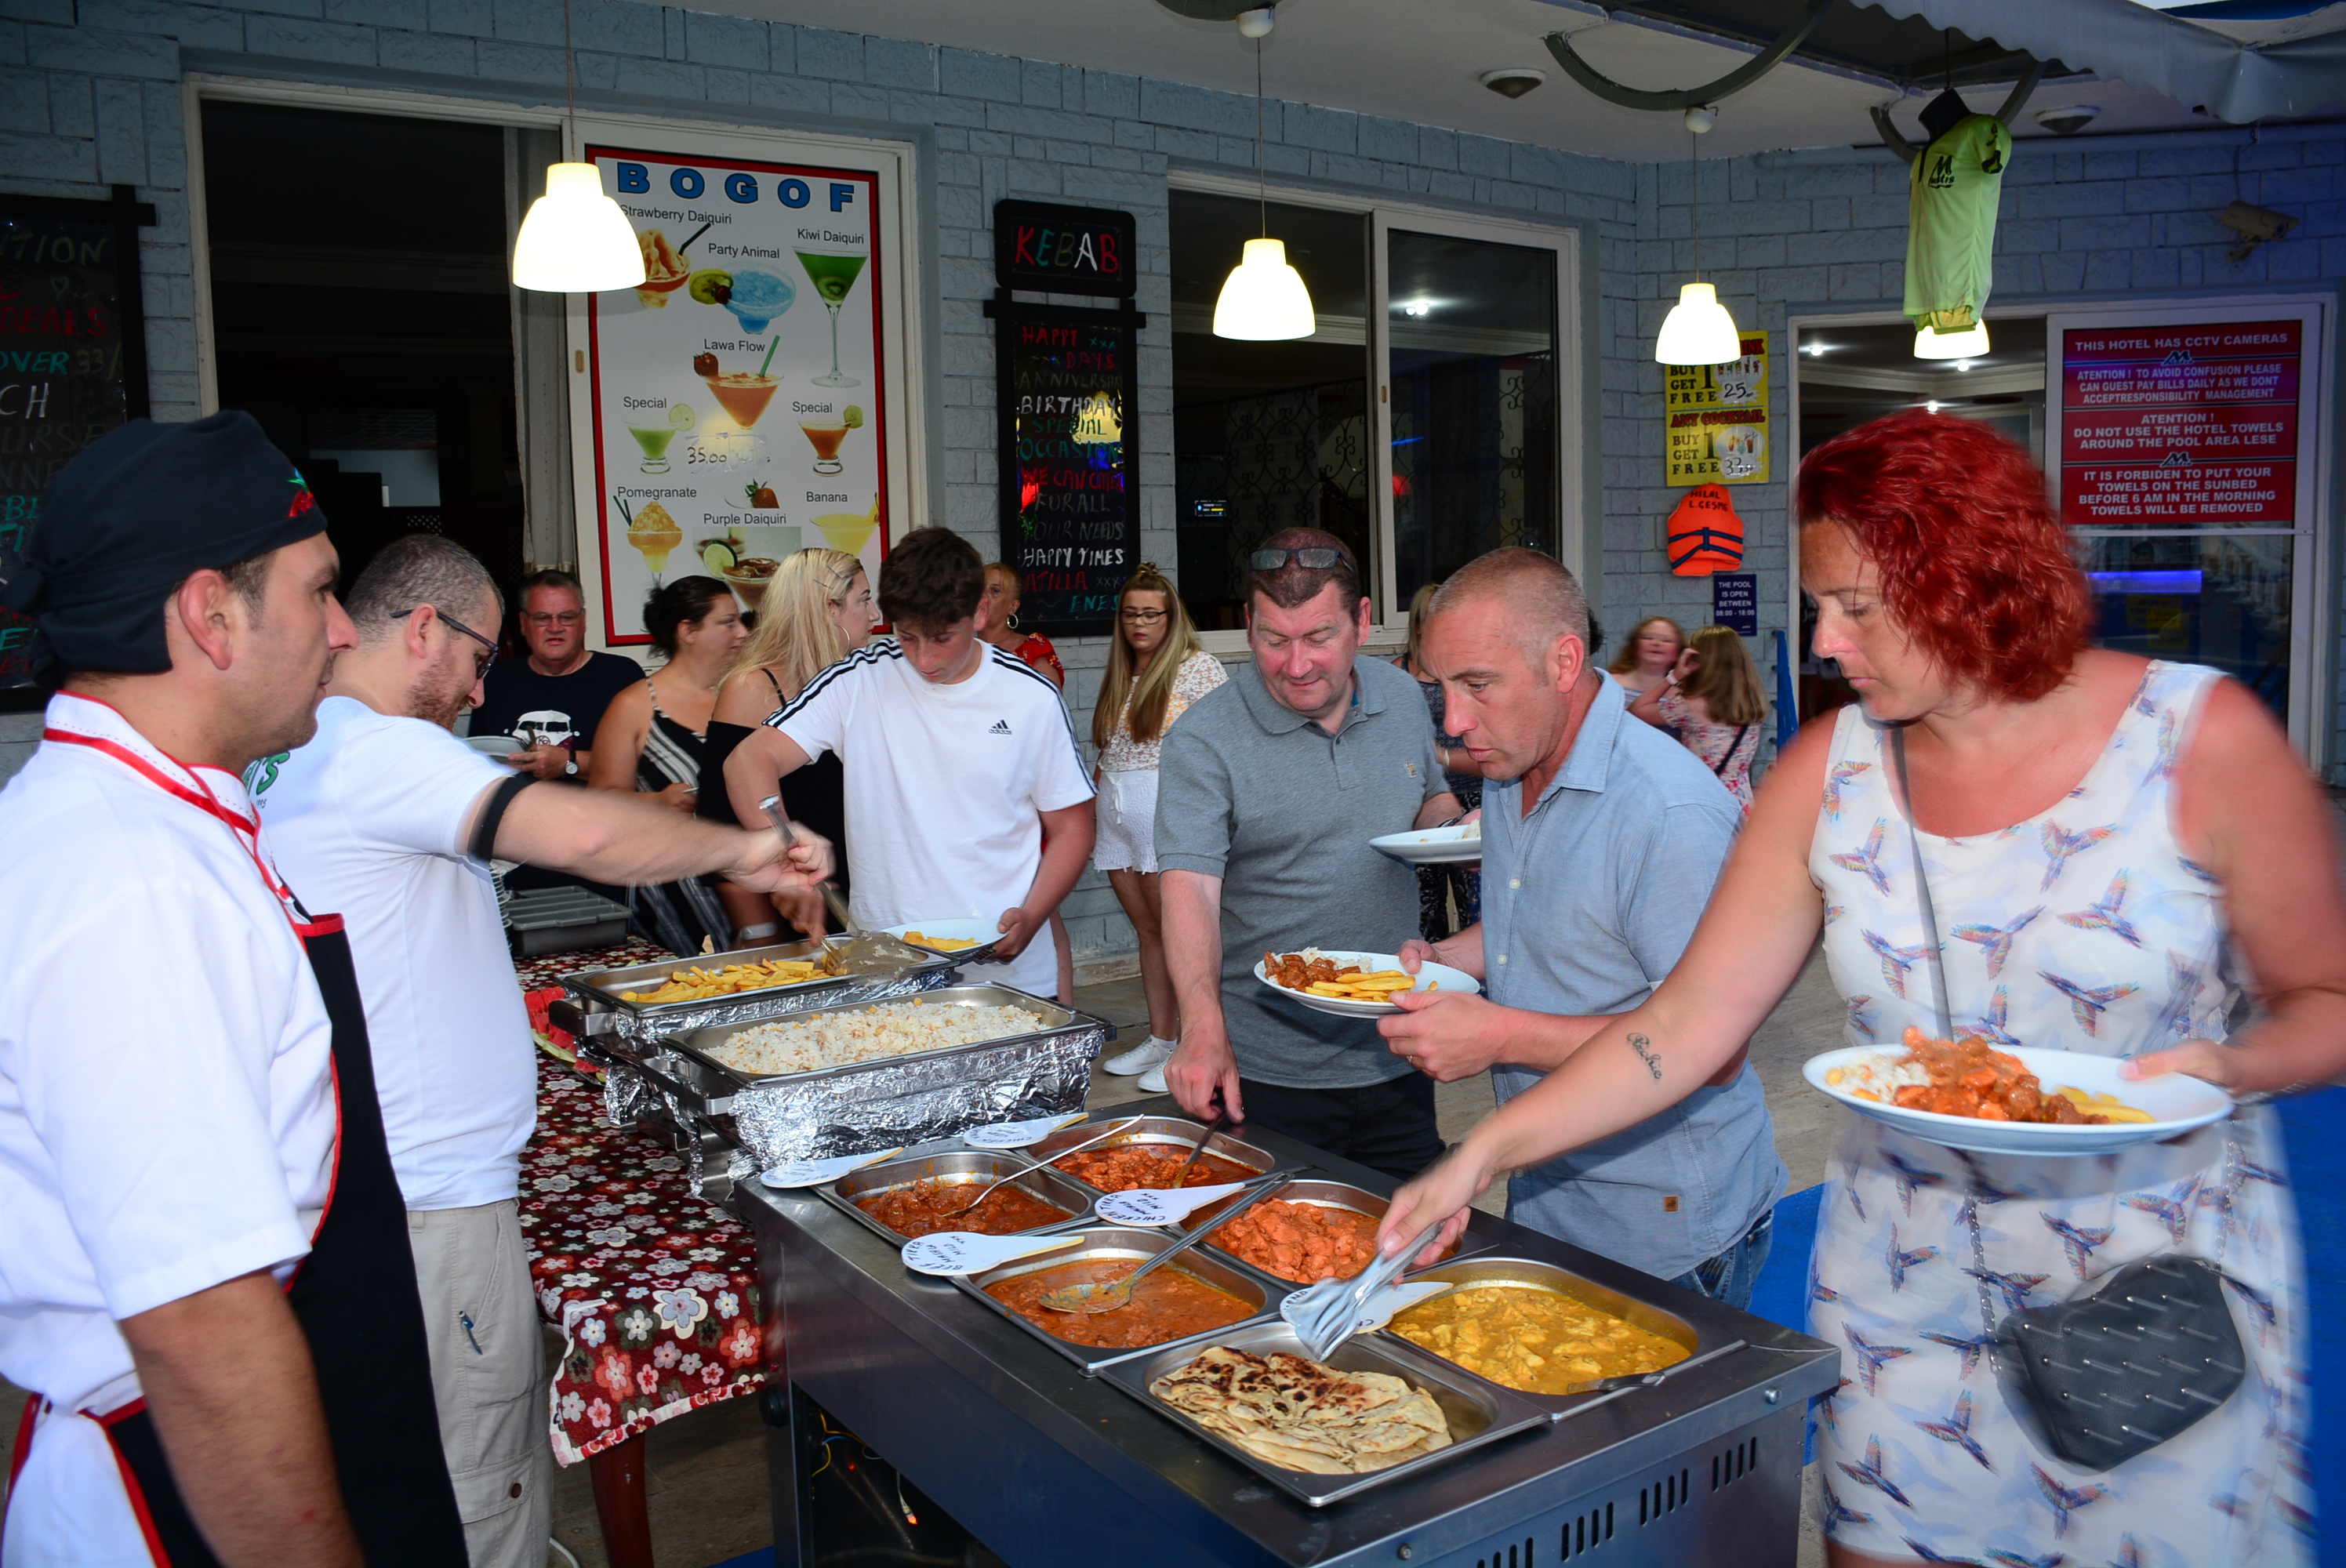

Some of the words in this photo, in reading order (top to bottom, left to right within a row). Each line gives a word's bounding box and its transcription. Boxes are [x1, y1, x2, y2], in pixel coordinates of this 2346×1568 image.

[617, 162, 855, 213] BOGOF
[688, 209, 732, 226] Daiquiri
[797, 228, 821, 243] Kiwi
[823, 230, 865, 245] Daiquiri
[0, 230, 108, 266] TION
[708, 243, 739, 259] Party
[741, 245, 780, 259] Animal
[1015, 225, 1119, 273] KEBAB
[1021, 325, 1078, 347] HAPPY
[2075, 340, 2105, 351] THIS
[2108, 339, 2151, 350] HOTEL
[2155, 337, 2181, 348] HAS
[2184, 336, 2220, 347] CCTV
[2224, 332, 2288, 346] CAMERAS
[704, 339, 735, 353] Lawa
[739, 339, 765, 353] Flow
[1066, 351, 1115, 371] DAYS
[1670, 365, 1696, 376] BUY
[2077, 370, 2126, 380] ATENTION
[2136, 368, 2149, 379] TO
[2152, 366, 2181, 378] AVOID
[2184, 365, 2241, 377] CONFUSION
[2244, 363, 2282, 375] PLEASE
[1670, 379, 1697, 390] GET
[2079, 382, 2100, 392] CAN
[2102, 381, 2134, 391] GUEST
[2137, 380, 2155, 390] PAY
[2158, 379, 2184, 390] BILLS
[2188, 378, 2216, 389] DAILY
[2217, 377, 2231, 387] AS
[2233, 376, 2248, 387] WE
[2251, 376, 2279, 386] DONT
[623, 396, 667, 410] Special
[1670, 391, 1717, 404] FREE
[2083, 391, 2200, 404] ACCEPTRESPONSIBILITY
[2205, 387, 2275, 400] MANAGEMENT
[792, 401, 833, 415] Special
[1020, 395, 1116, 418] BIRTHDAY
[1032, 417, 1107, 435] SPECIAL
[1670, 413, 1700, 428] ANY
[1701, 409, 1765, 426] COCKTAIL
[2141, 412, 2206, 424] ATENTION
[2073, 428, 2092, 437] DO
[2095, 426, 2122, 437] NOT
[2125, 426, 2151, 437] USE
[2155, 425, 2180, 436] THE
[2184, 423, 2227, 434] HOTEL
[2230, 422, 2283, 433] TOWELS
[1672, 434, 1700, 446] BUY
[1704, 431, 1718, 459] 1
[2079, 438, 2134, 449] AROUND
[2137, 437, 2163, 448] THE
[2166, 436, 2202, 448] POOL
[2205, 435, 2240, 446] AREA
[2243, 434, 2277, 445] LESE
[687, 446, 727, 464] 35.00
[1673, 449, 1699, 460] GET
[1672, 462, 1719, 474] FREE
[2084, 471, 2097, 481] IT
[2100, 470, 2112, 481] IS
[2116, 469, 2181, 481] FORBIDEN
[2184, 468, 2202, 479] TO
[2205, 467, 2232, 478] PUT
[2235, 466, 2272, 477] YOUR
[1021, 466, 1049, 485] WE
[1053, 470, 1087, 490] CAN
[2097, 481, 2148, 492] TOWELS
[2152, 481, 2170, 492] ON
[2174, 480, 2200, 491] THE
[2204, 479, 2257, 490] SUNBED
[617, 486, 697, 501] Pomegranate
[806, 491, 848, 503] Banana
[2079, 493, 2129, 504] BEFORE
[2132, 493, 2140, 503] 6
[2143, 492, 2163, 503] AM
[2166, 492, 2181, 503] IN
[2184, 492, 2210, 502] THE
[2213, 490, 2275, 502] MORNING
[1032, 492, 1073, 513] FOR
[1077, 493, 1110, 514] ALL
[2090, 505, 2142, 516] TOWELS
[2144, 504, 2177, 514] WILL
[2180, 503, 2197, 514] BE
[2200, 503, 2263, 514] REMOVED
[703, 513, 740, 527] Purple
[743, 513, 787, 526] Daiquiri
[1021, 514, 1073, 542] YOUR
[1079, 521, 1124, 542] NEEDS
[1021, 546, 1072, 568] HAPPY
[1023, 570, 1089, 593] ATILLA
[1137, 1199, 1164, 1209] MILD
[1102, 1211, 1165, 1221] CHICKEN
[906, 1241, 924, 1261] TIKKA
[943, 1243, 967, 1255] MILD
[920, 1262, 964, 1271] BEEF
